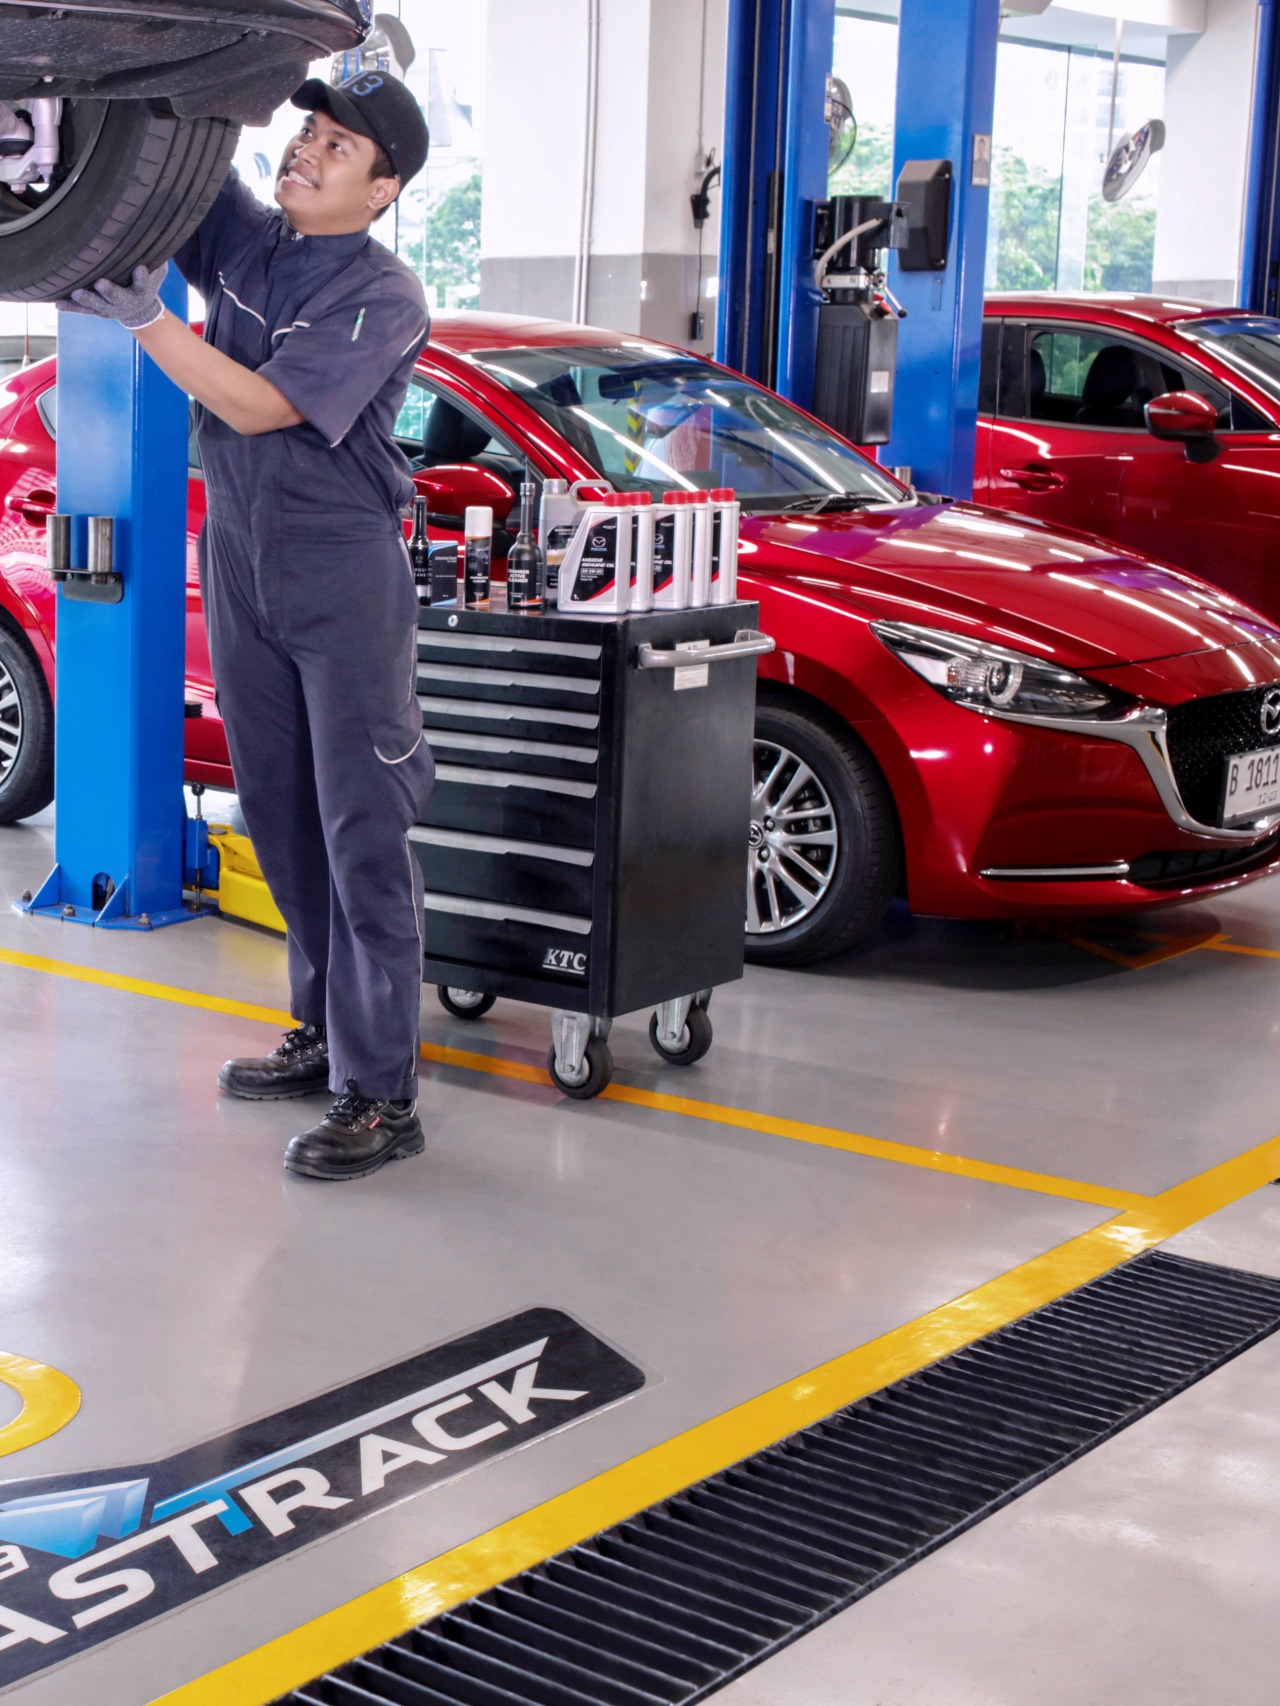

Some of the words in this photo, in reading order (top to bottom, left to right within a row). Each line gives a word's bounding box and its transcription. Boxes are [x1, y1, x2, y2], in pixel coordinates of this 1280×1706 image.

[1229, 763, 1239, 796] B
[1245, 753, 1279, 792] 1811
[543, 948, 587, 971] KTC
